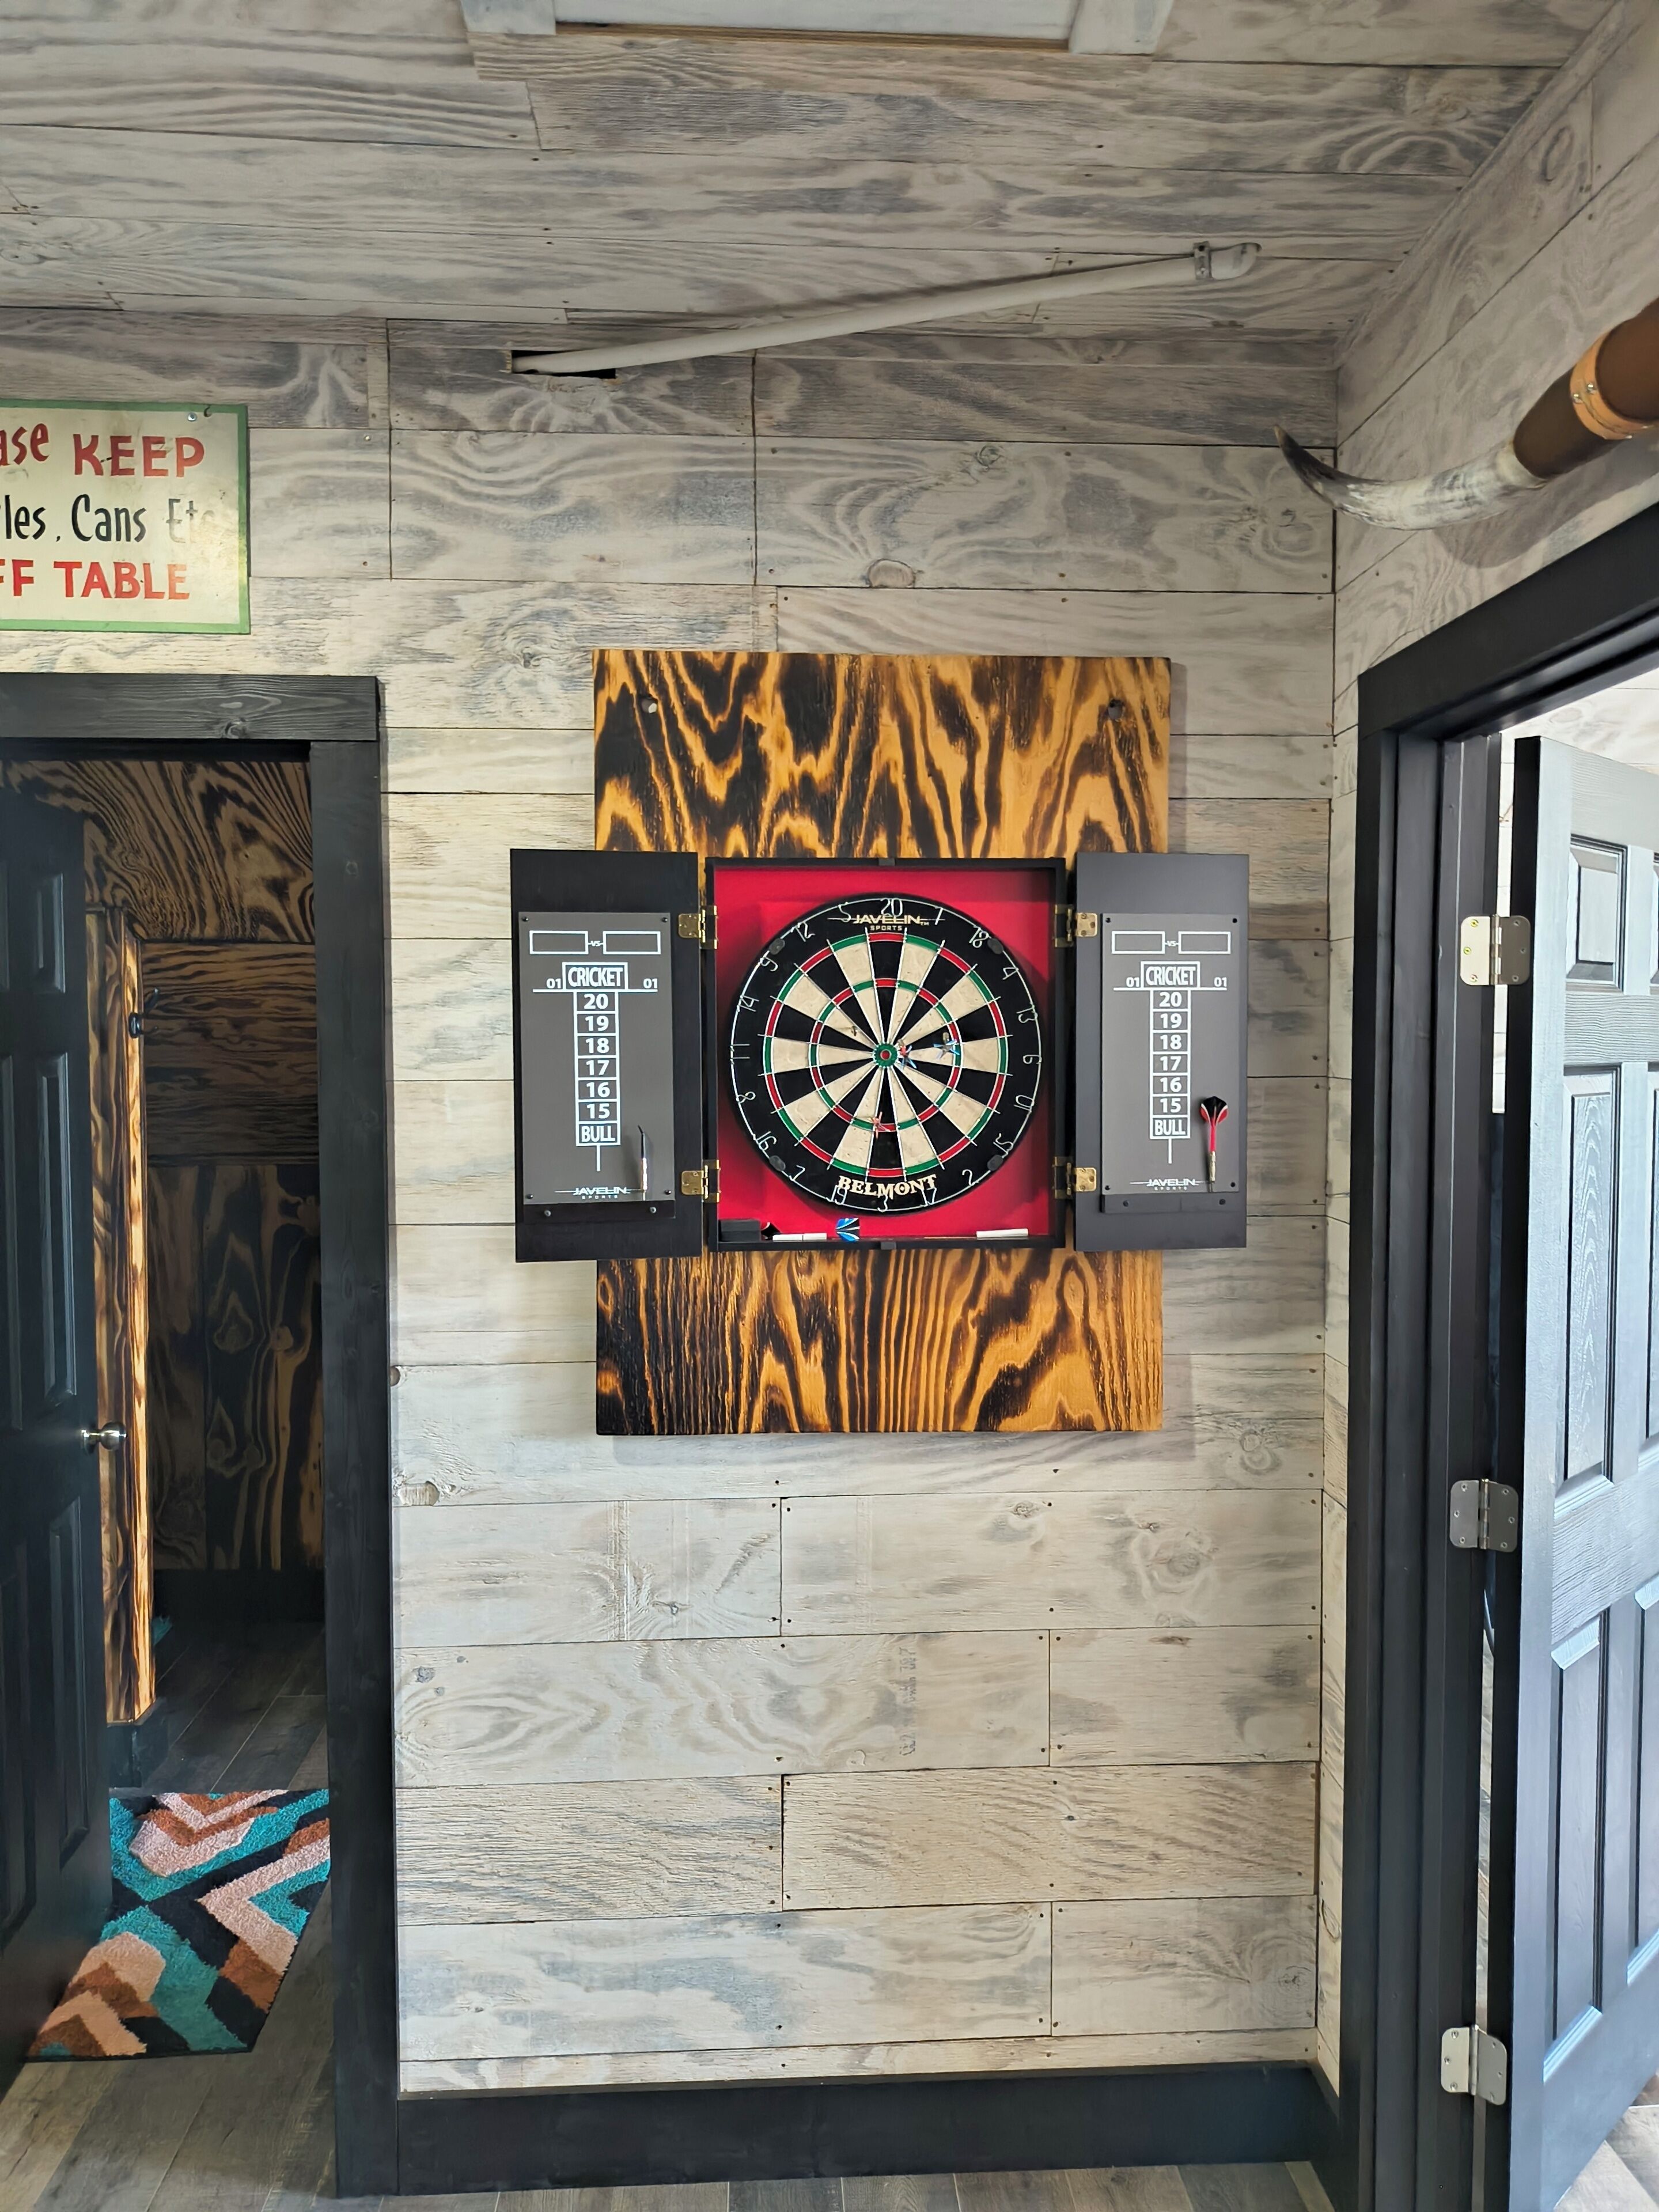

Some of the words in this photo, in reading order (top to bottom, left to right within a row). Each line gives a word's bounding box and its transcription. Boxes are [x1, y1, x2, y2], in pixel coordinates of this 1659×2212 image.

[73, 434, 205, 478] KEEP
[71, 494, 147, 543] Cans
[0, 559, 34, 597] F
[53, 560, 190, 600] TABLE
[838, 902, 851, 923] 5
[880, 897, 903, 917] 20
[853, 914, 921, 925] JAVELIN
[791, 921, 816, 942] 12
[969, 926, 989, 948] 18
[546, 978, 562, 989] 01
[567, 967, 623, 987] CRICKET
[643, 978, 658, 989] 01
[1126, 976, 1139, 987] 01
[1145, 966, 1196, 986] CRICKET
[1214, 976, 1228, 987] 01
[584, 993, 609, 1009] 20
[1159, 991, 1182, 1007] 20
[585, 1015, 609, 1032] 19
[1160, 1013, 1182, 1029] 19
[585, 1037, 609, 1054] 18
[1160, 1034, 1182, 1050] 18
[586, 1059, 610, 1076] 17
[1160, 1055, 1182, 1071] 17
[586, 1081, 611, 1098] 16
[1160, 1077, 1182, 1093] 16
[736, 1091, 756, 1104] 8
[1160, 1097, 1181, 1113] 15
[586, 1103, 611, 1119] 15
[581, 1125, 616, 1143] BULL
[1154, 1119, 1186, 1136] BULL
[838, 1173, 937, 1200] BELMONT
[1146, 1178, 1198, 1187] JAVELIN
[572, 1187, 630, 1196] JAVELIN
